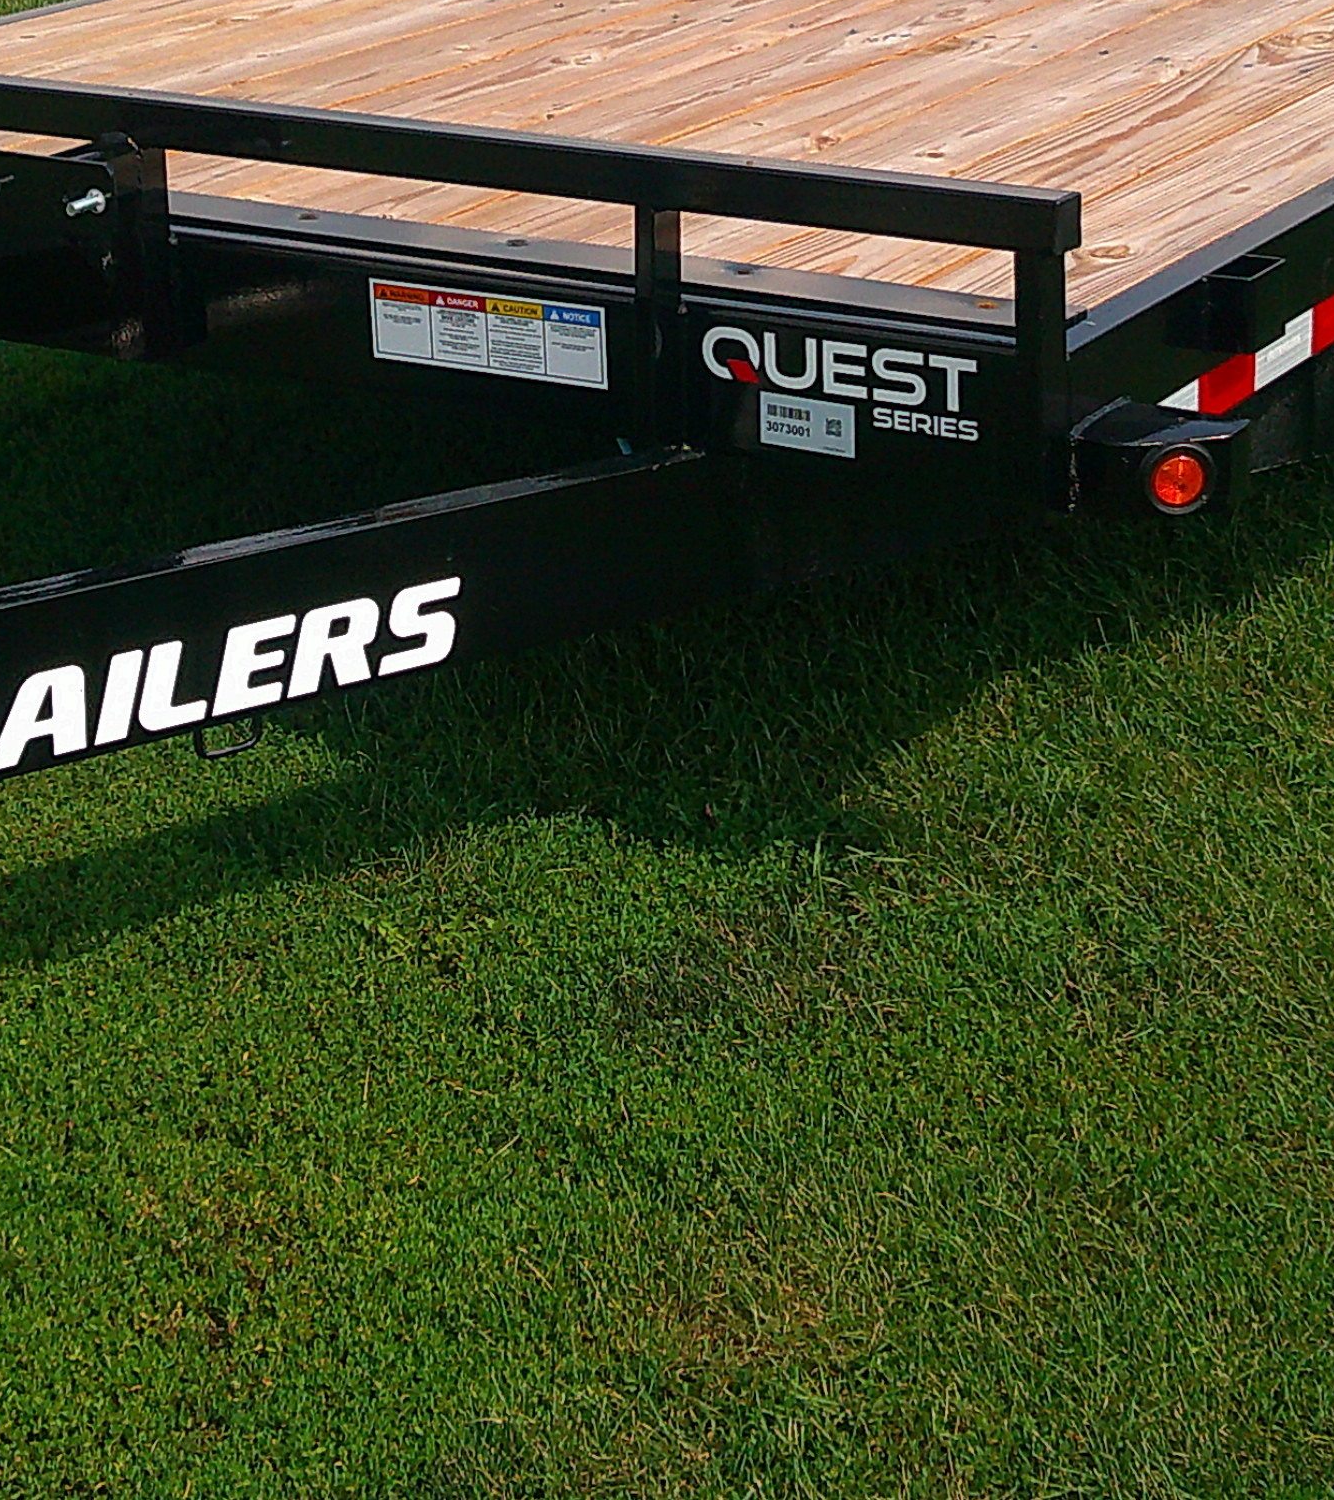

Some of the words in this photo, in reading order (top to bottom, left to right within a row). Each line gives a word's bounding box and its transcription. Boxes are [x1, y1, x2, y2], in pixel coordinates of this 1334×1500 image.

[446, 296, 479, 310] DANGER
[502, 304, 538, 316] CAUTION
[562, 311, 591, 324] NOTICE
[702, 326, 978, 412] QUEST
[766, 419, 811, 438] 3073001
[872, 407, 979, 442] SERIES
